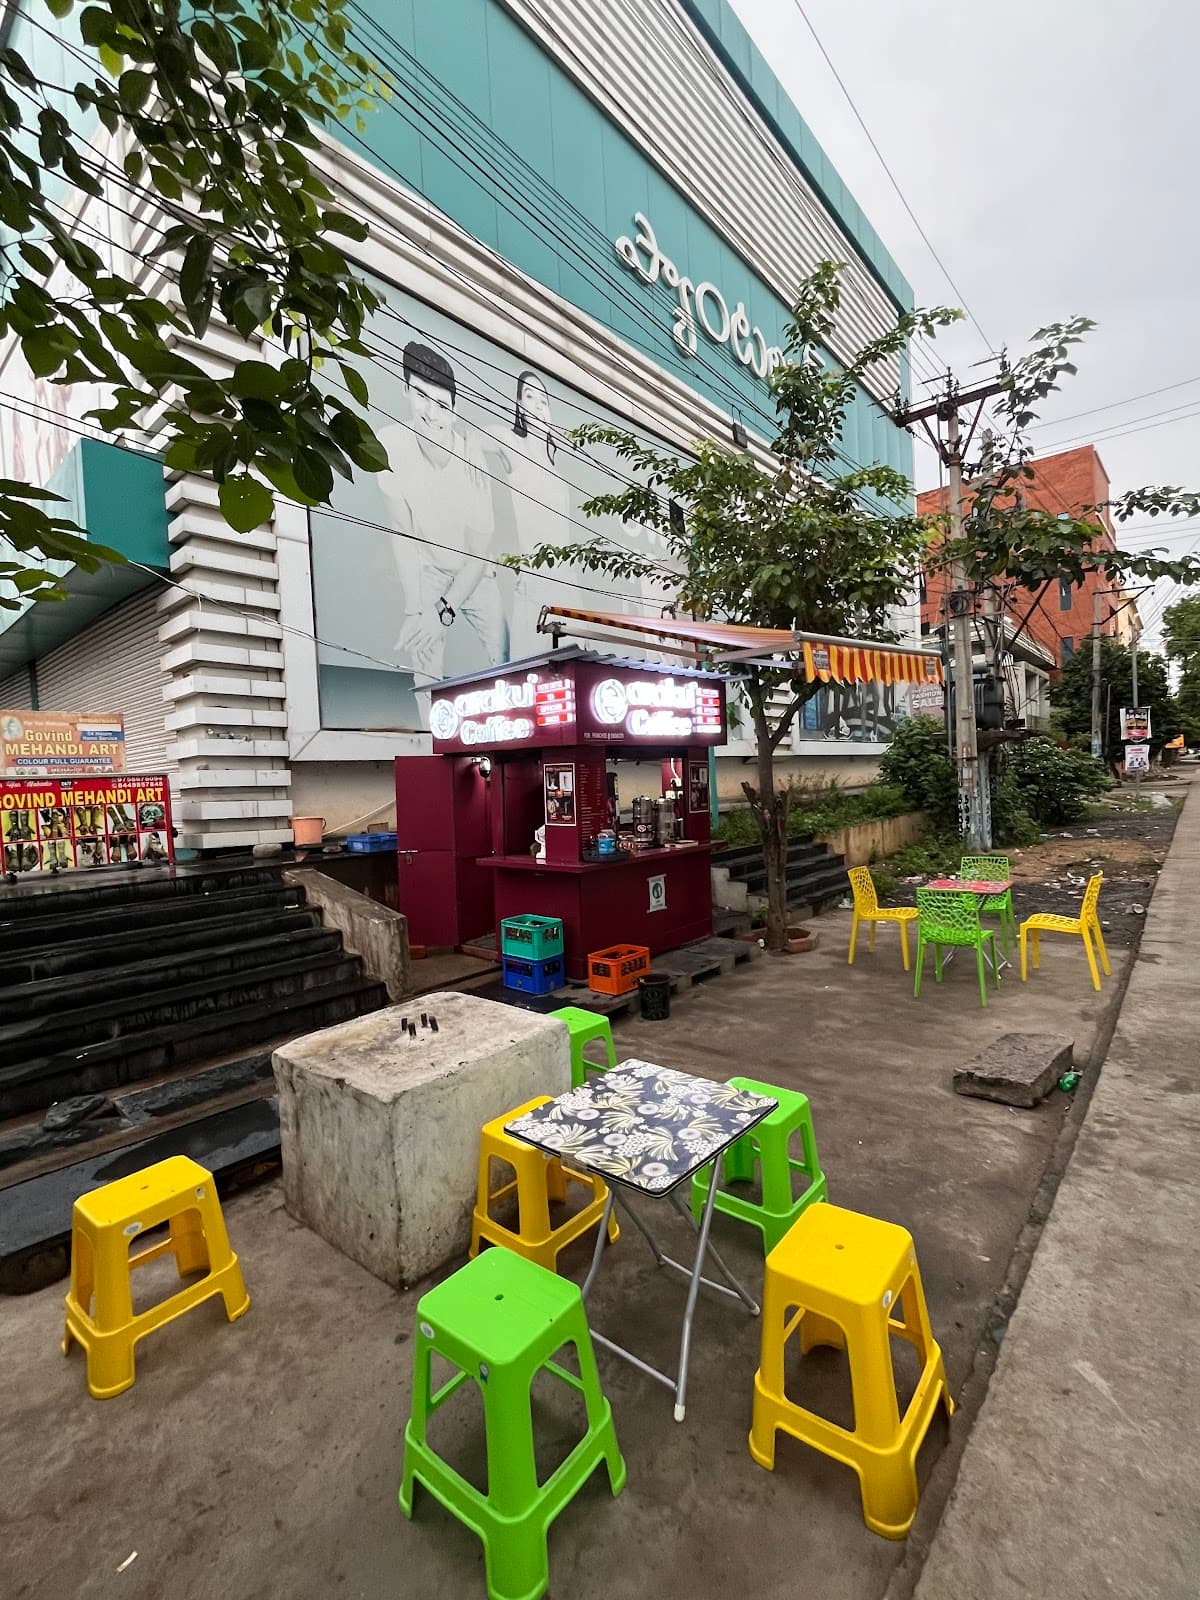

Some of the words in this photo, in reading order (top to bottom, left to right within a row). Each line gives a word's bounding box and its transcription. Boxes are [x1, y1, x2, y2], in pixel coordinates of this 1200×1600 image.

[911, 691, 943, 700] FASHION
[912, 696, 945, 709] SALE
[25, 729, 73, 741] Govind
[460, 715, 530, 744] Coffee
[5, 743, 83, 755] MEHANDI
[89, 743, 119, 755] ART
[0, 792, 56, 809] OVIND
[61, 788, 132, 806] MEHANDI
[136, 787, 164, 802] ART
